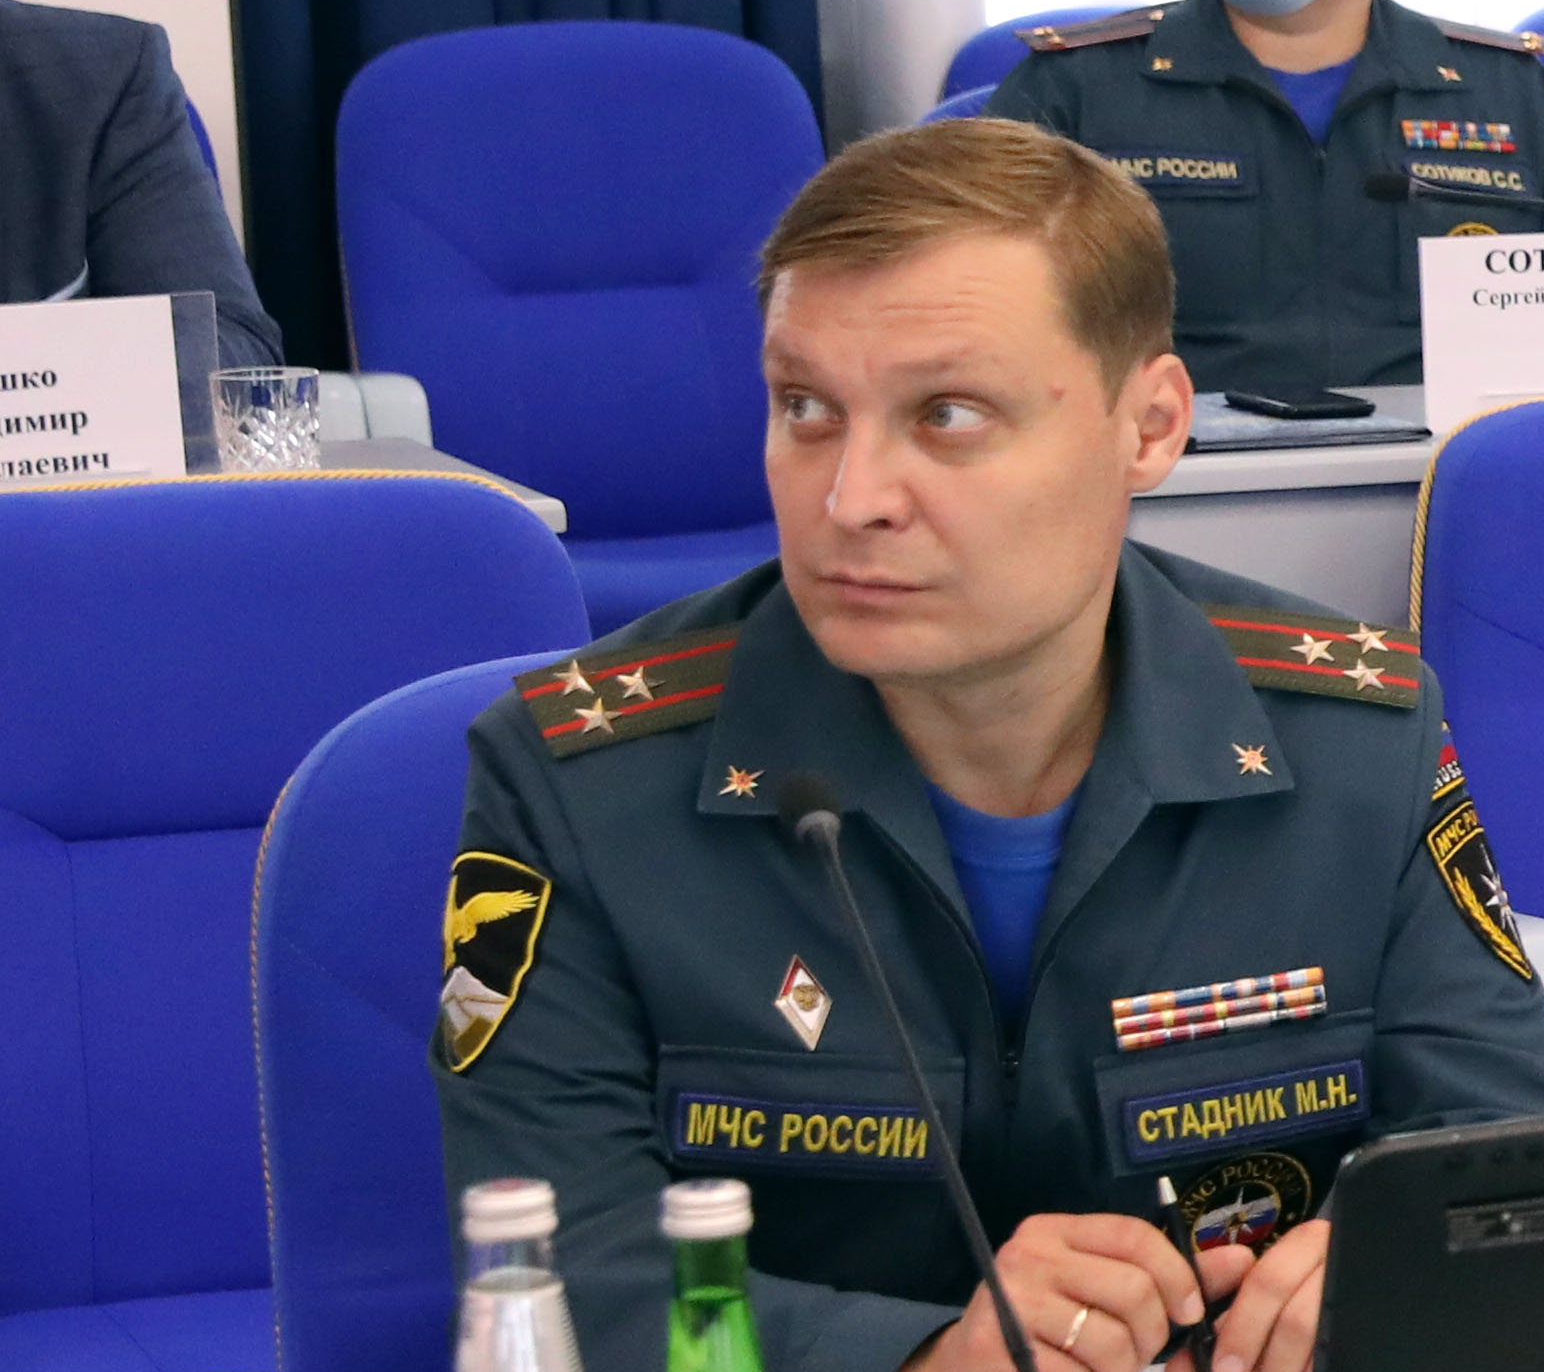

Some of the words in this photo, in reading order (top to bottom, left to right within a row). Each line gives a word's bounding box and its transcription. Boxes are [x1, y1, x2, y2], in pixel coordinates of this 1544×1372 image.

[1156, 157, 1237, 179] РОССИИ
[0, 410, 89, 437] имир
[1136, 1086, 1286, 1143] СТАДНИК
[1294, 1074, 1358, 1113] М.Н.
[686, 1102, 766, 1149] МЧС
[779, 1114, 930, 1159] РОССИИ
